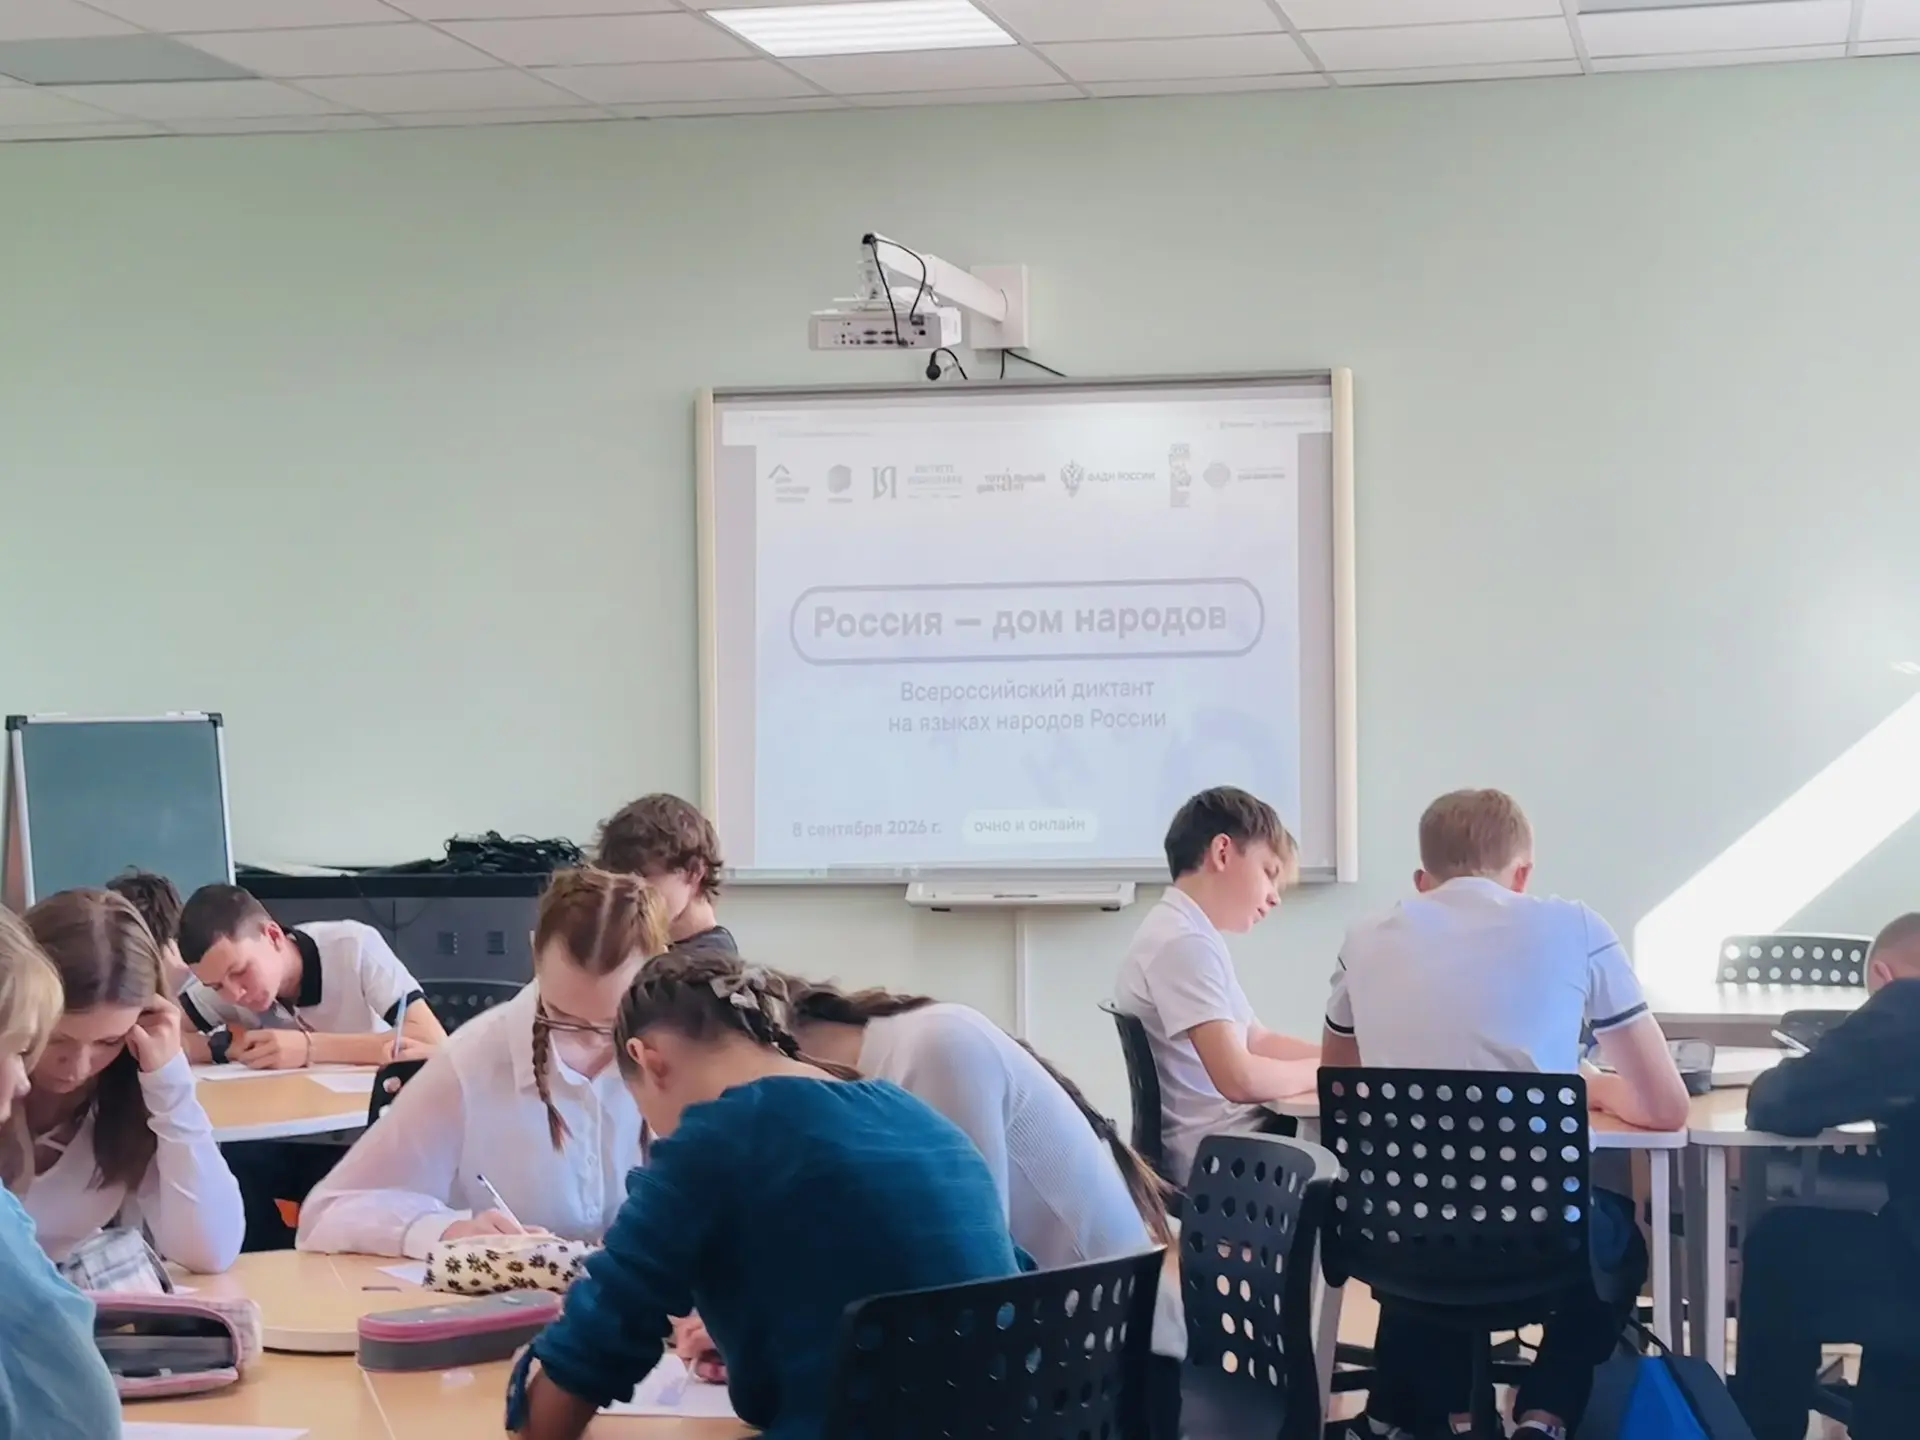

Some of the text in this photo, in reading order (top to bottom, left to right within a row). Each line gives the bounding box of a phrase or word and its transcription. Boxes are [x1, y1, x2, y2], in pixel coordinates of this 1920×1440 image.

[814, 606, 943, 638] Россия
[992, 609, 1063, 641] дом
[1075, 606, 1227, 639] народов
[900, 678, 1155, 704] Всероссийский диктант
[888, 708, 1166, 734] на языках народов России
[792, 819, 942, 840] 8 сентября 2026 г.
[974, 816, 1086, 834] очно и онлайн
